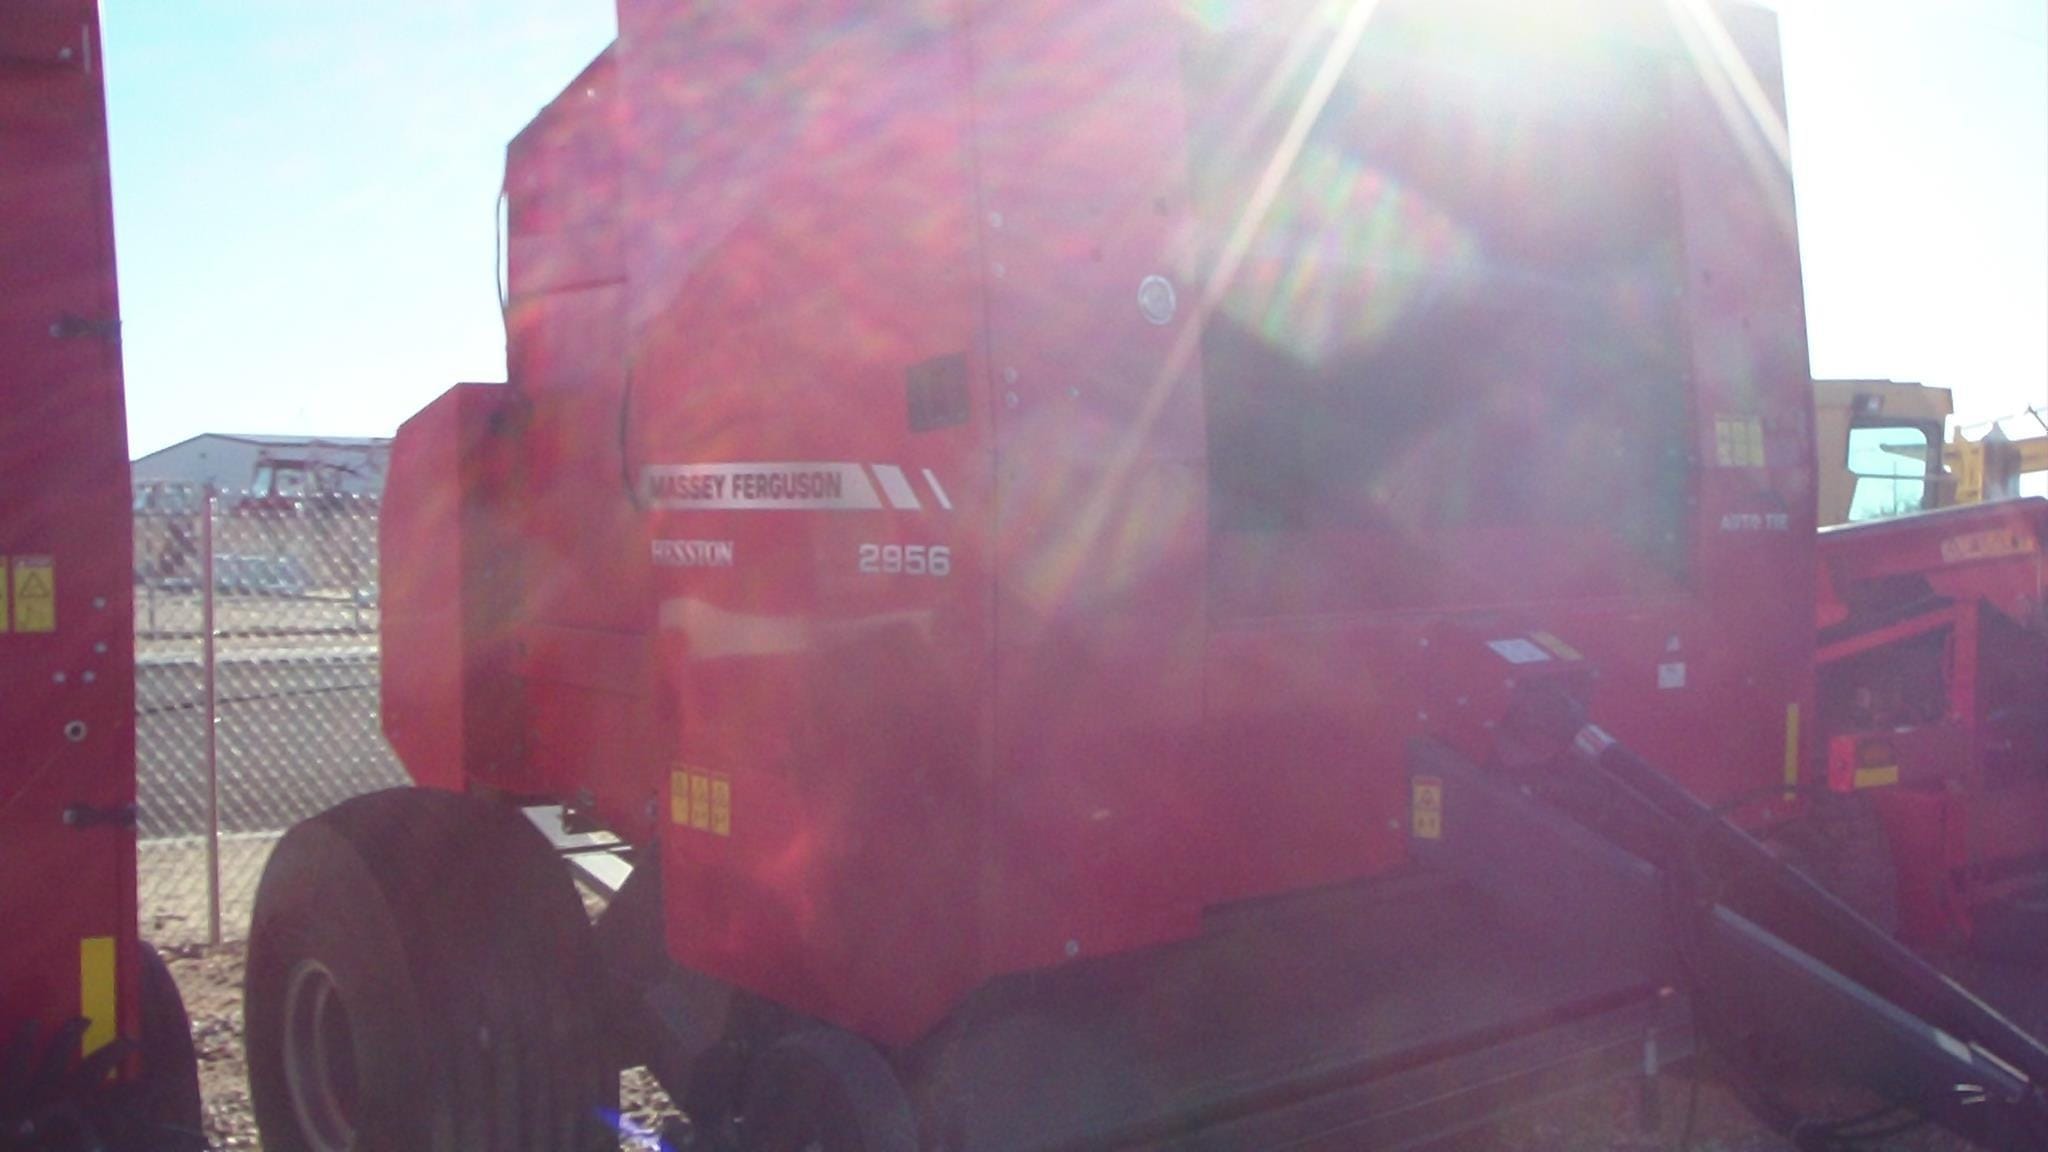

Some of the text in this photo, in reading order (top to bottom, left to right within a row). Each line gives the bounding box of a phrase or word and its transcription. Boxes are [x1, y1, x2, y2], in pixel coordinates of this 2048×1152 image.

[650, 471, 842, 499] MASSEY FERGUSON
[858, 543, 950, 576] 2956
